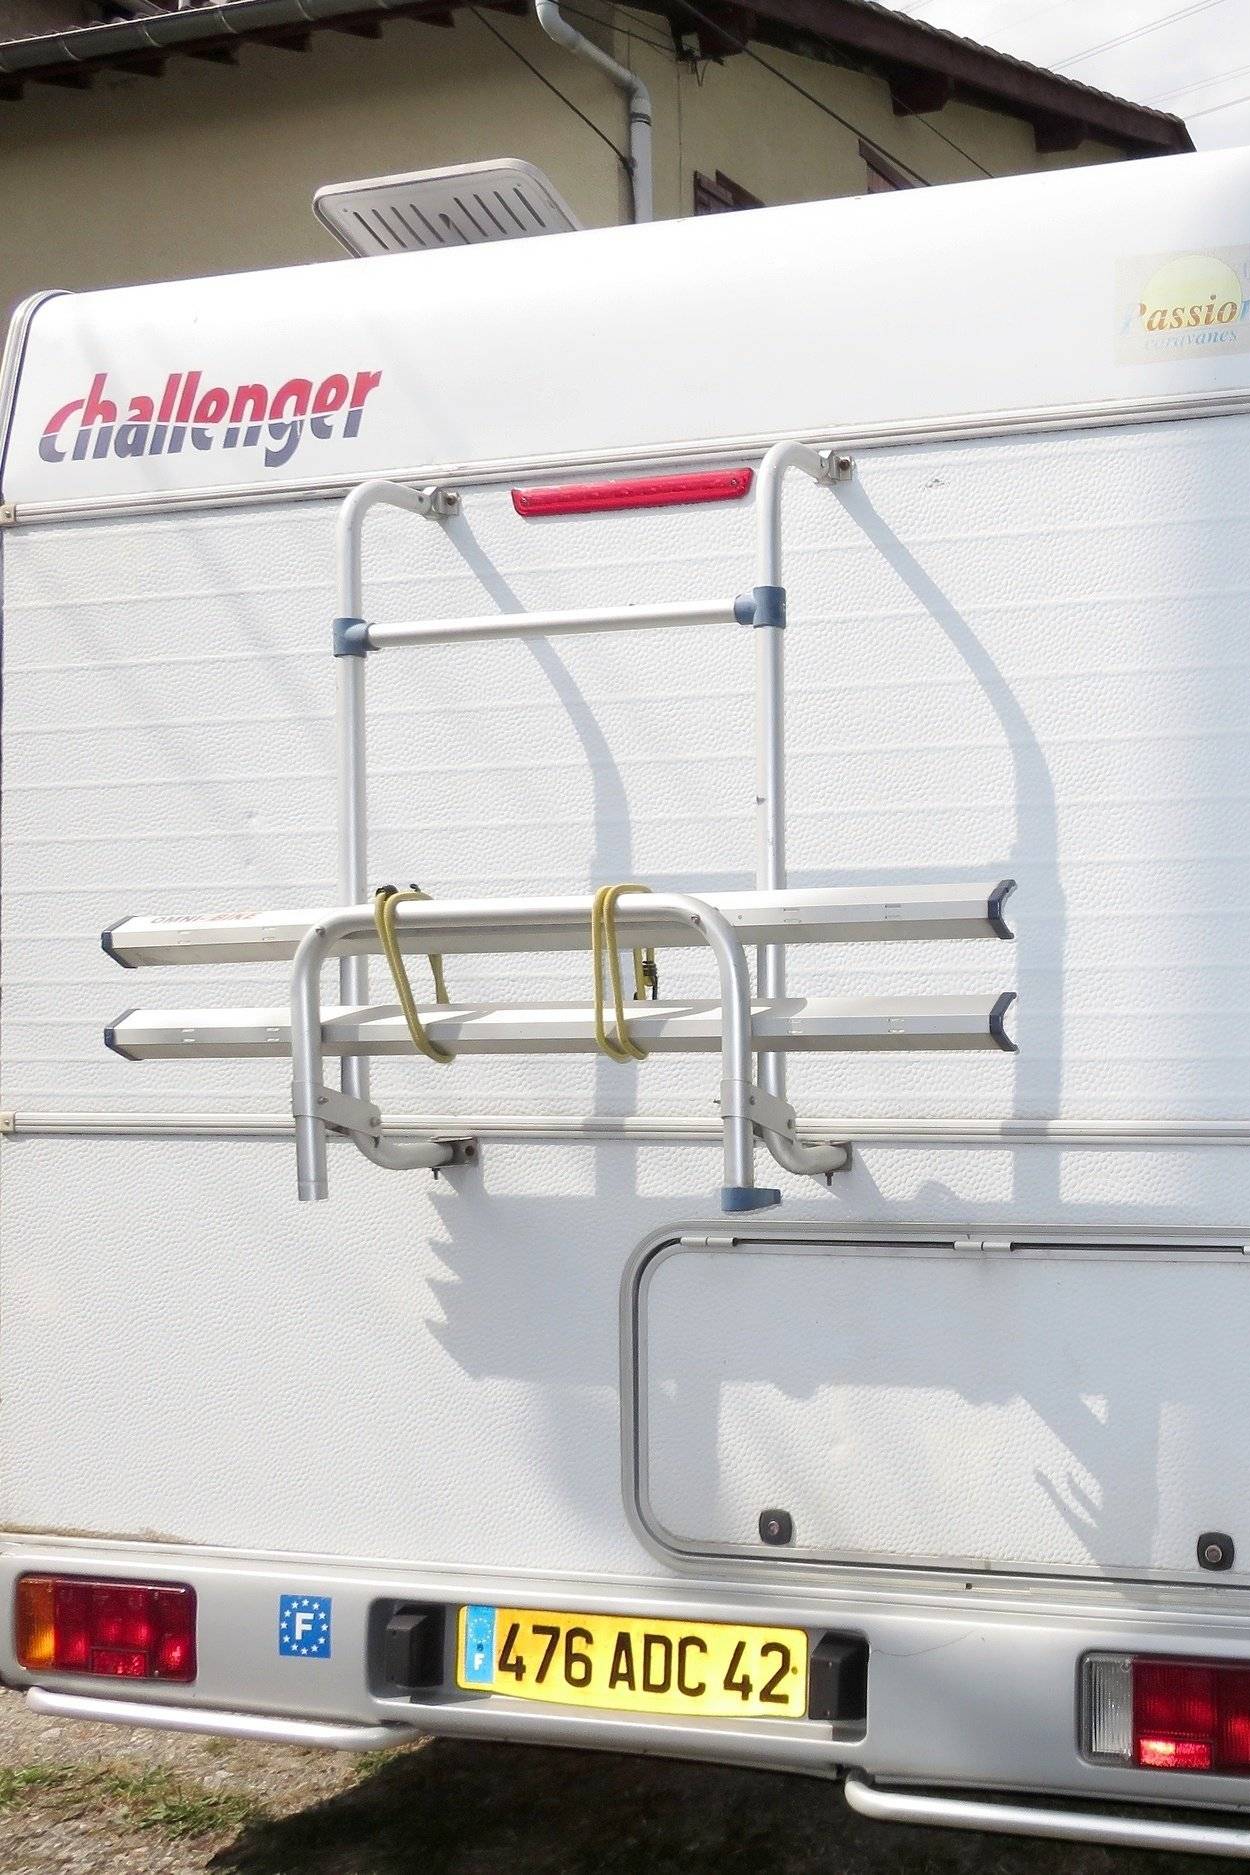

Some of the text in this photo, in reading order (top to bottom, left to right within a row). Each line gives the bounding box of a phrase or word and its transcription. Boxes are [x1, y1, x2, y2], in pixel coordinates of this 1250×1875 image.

[295, 1612, 315, 1640] F
[472, 1652, 486, 1671] F
[498, 1622, 792, 1704] 476 ADC 42
